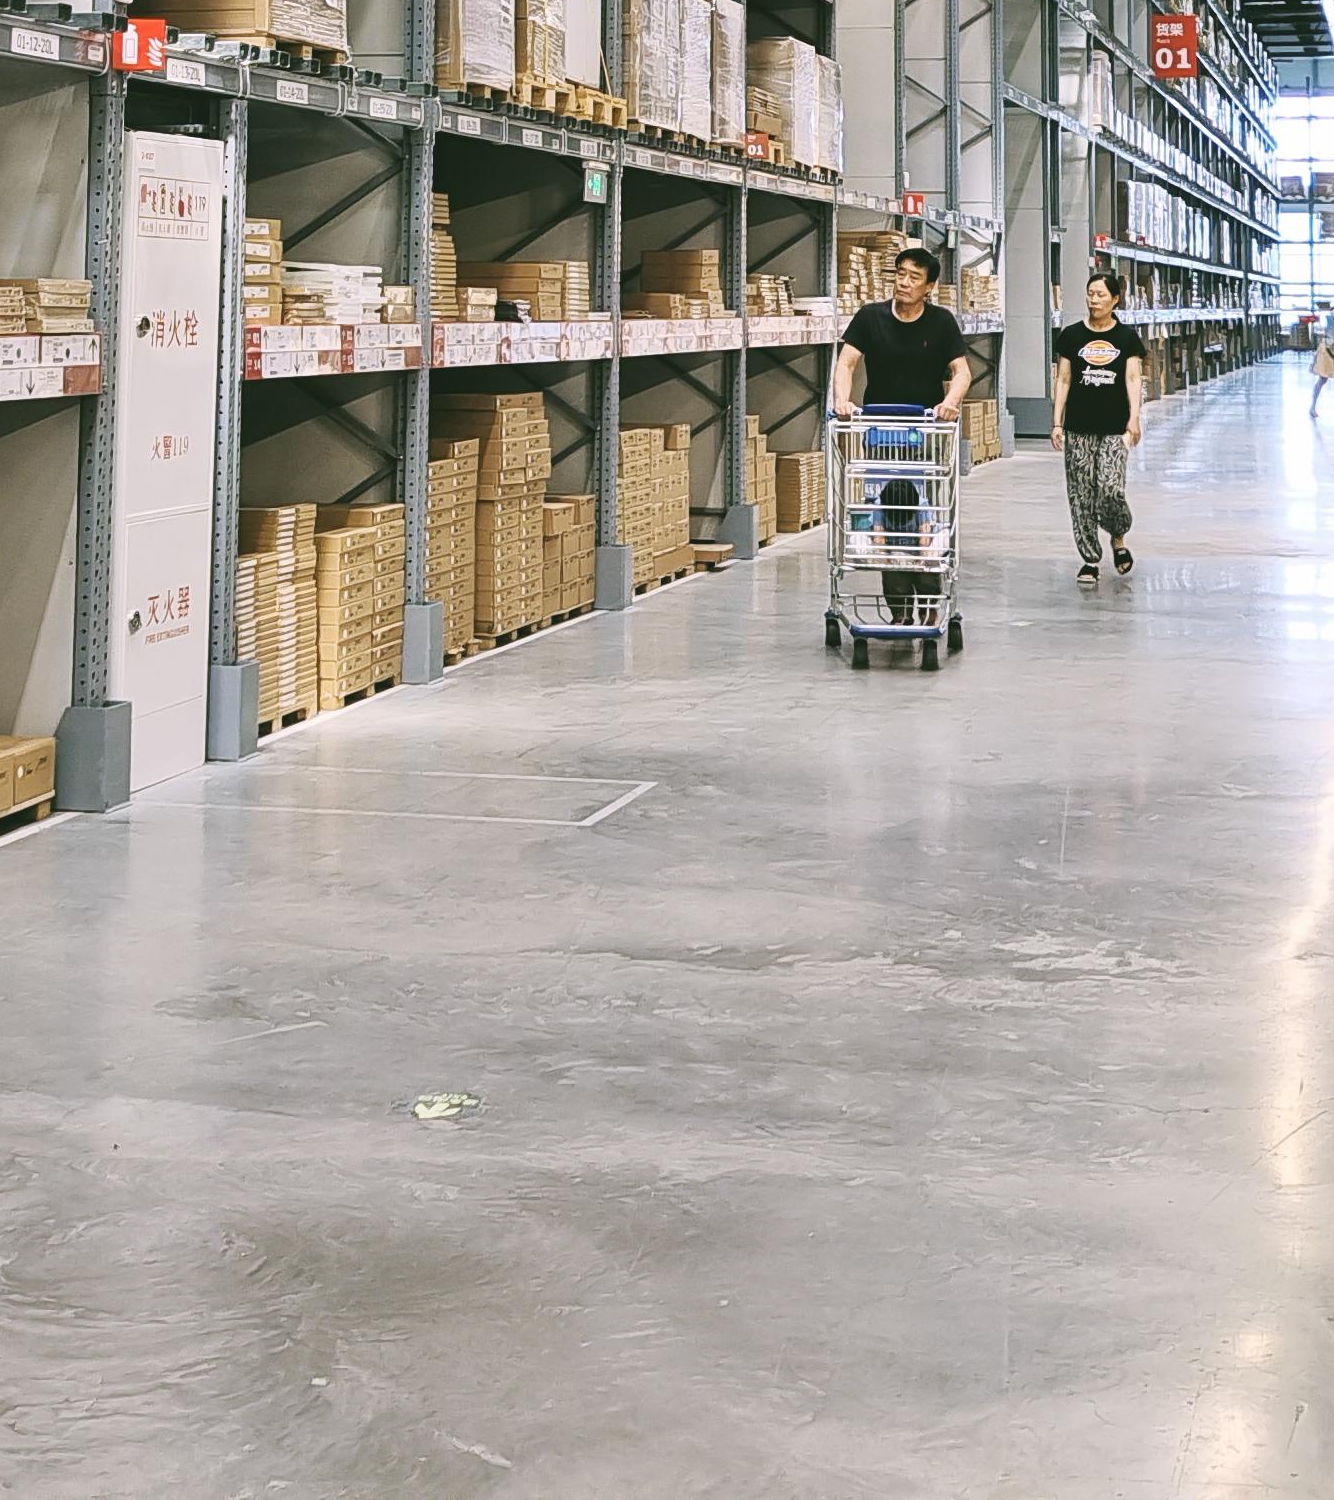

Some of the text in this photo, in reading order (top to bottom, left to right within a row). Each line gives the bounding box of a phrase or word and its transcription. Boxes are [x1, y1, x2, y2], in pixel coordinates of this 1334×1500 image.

[1155, 22, 1184, 37] 货架
[1155, 48, 1192, 69] 01
[151, 309, 199, 349] 消火栓
[145, 585, 189, 627] 灭火器
